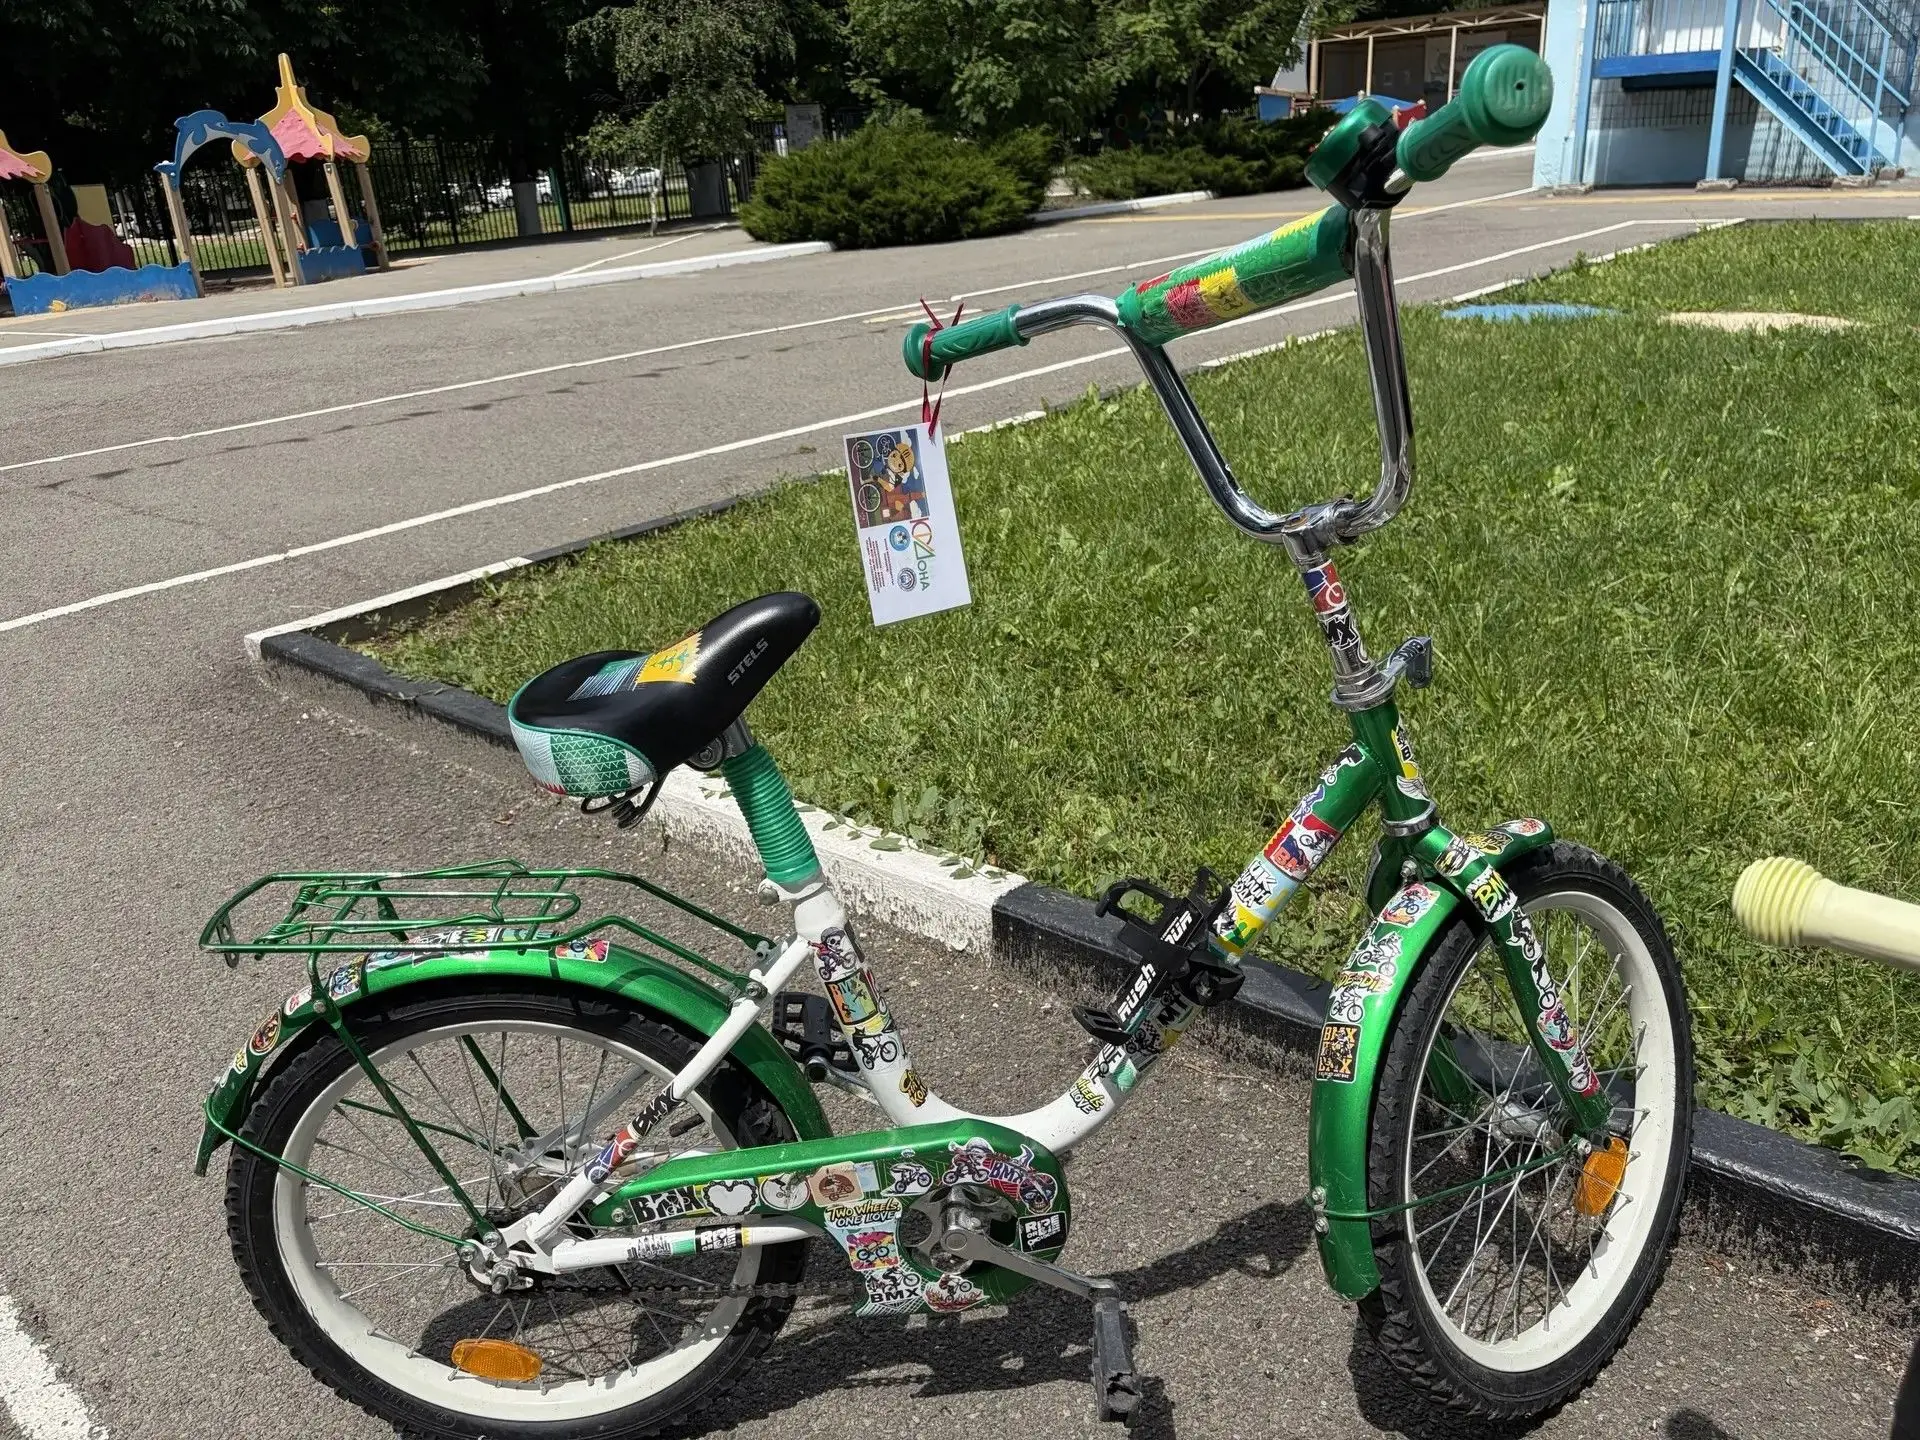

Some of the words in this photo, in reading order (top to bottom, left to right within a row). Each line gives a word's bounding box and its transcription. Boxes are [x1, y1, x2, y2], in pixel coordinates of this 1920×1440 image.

[727, 638, 769, 686] STELS
[631, 1083, 678, 1137] BMX
[990, 1161, 1025, 1184] BMX
[633, 1187, 700, 1223] BMX
[825, 1205, 853, 1222] TWO
[836, 1214, 862, 1228] ONE
[864, 1210, 896, 1224] LOVE
[871, 1286, 920, 1303] BMX
